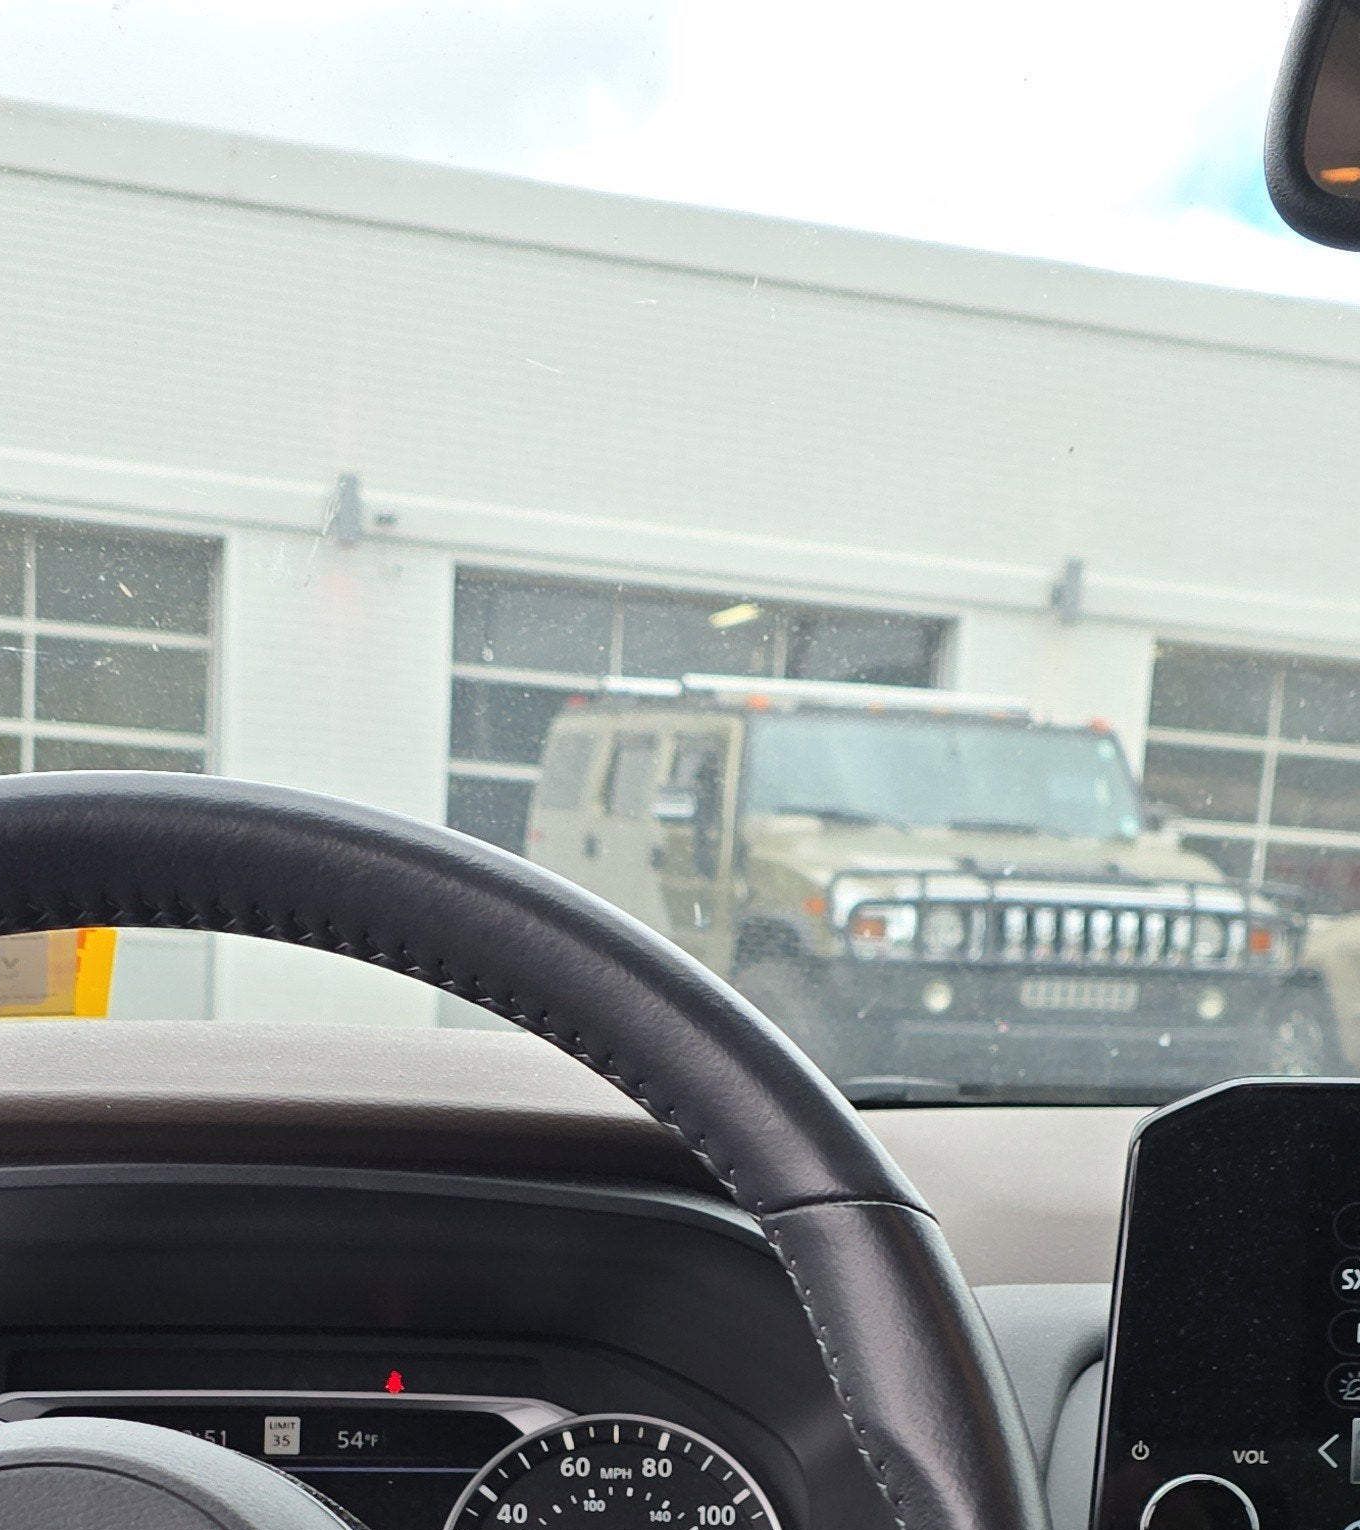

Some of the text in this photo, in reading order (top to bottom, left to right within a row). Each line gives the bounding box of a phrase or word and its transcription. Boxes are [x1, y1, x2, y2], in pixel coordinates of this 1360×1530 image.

[269, 1421, 296, 1431] LIMIT
[272, 1434, 291, 1447] 35
[1233, 1450, 1269, 1465] VOL
[560, 1457, 591, 1478] 60
[600, 1467, 632, 1480] MPH
[641, 1458, 673, 1479] 80
[583, 1499, 606, 1513] 100
[496, 1503, 528, 1524] 40
[649, 1510, 672, 1524] 140
[697, 1505, 737, 1527] 100
